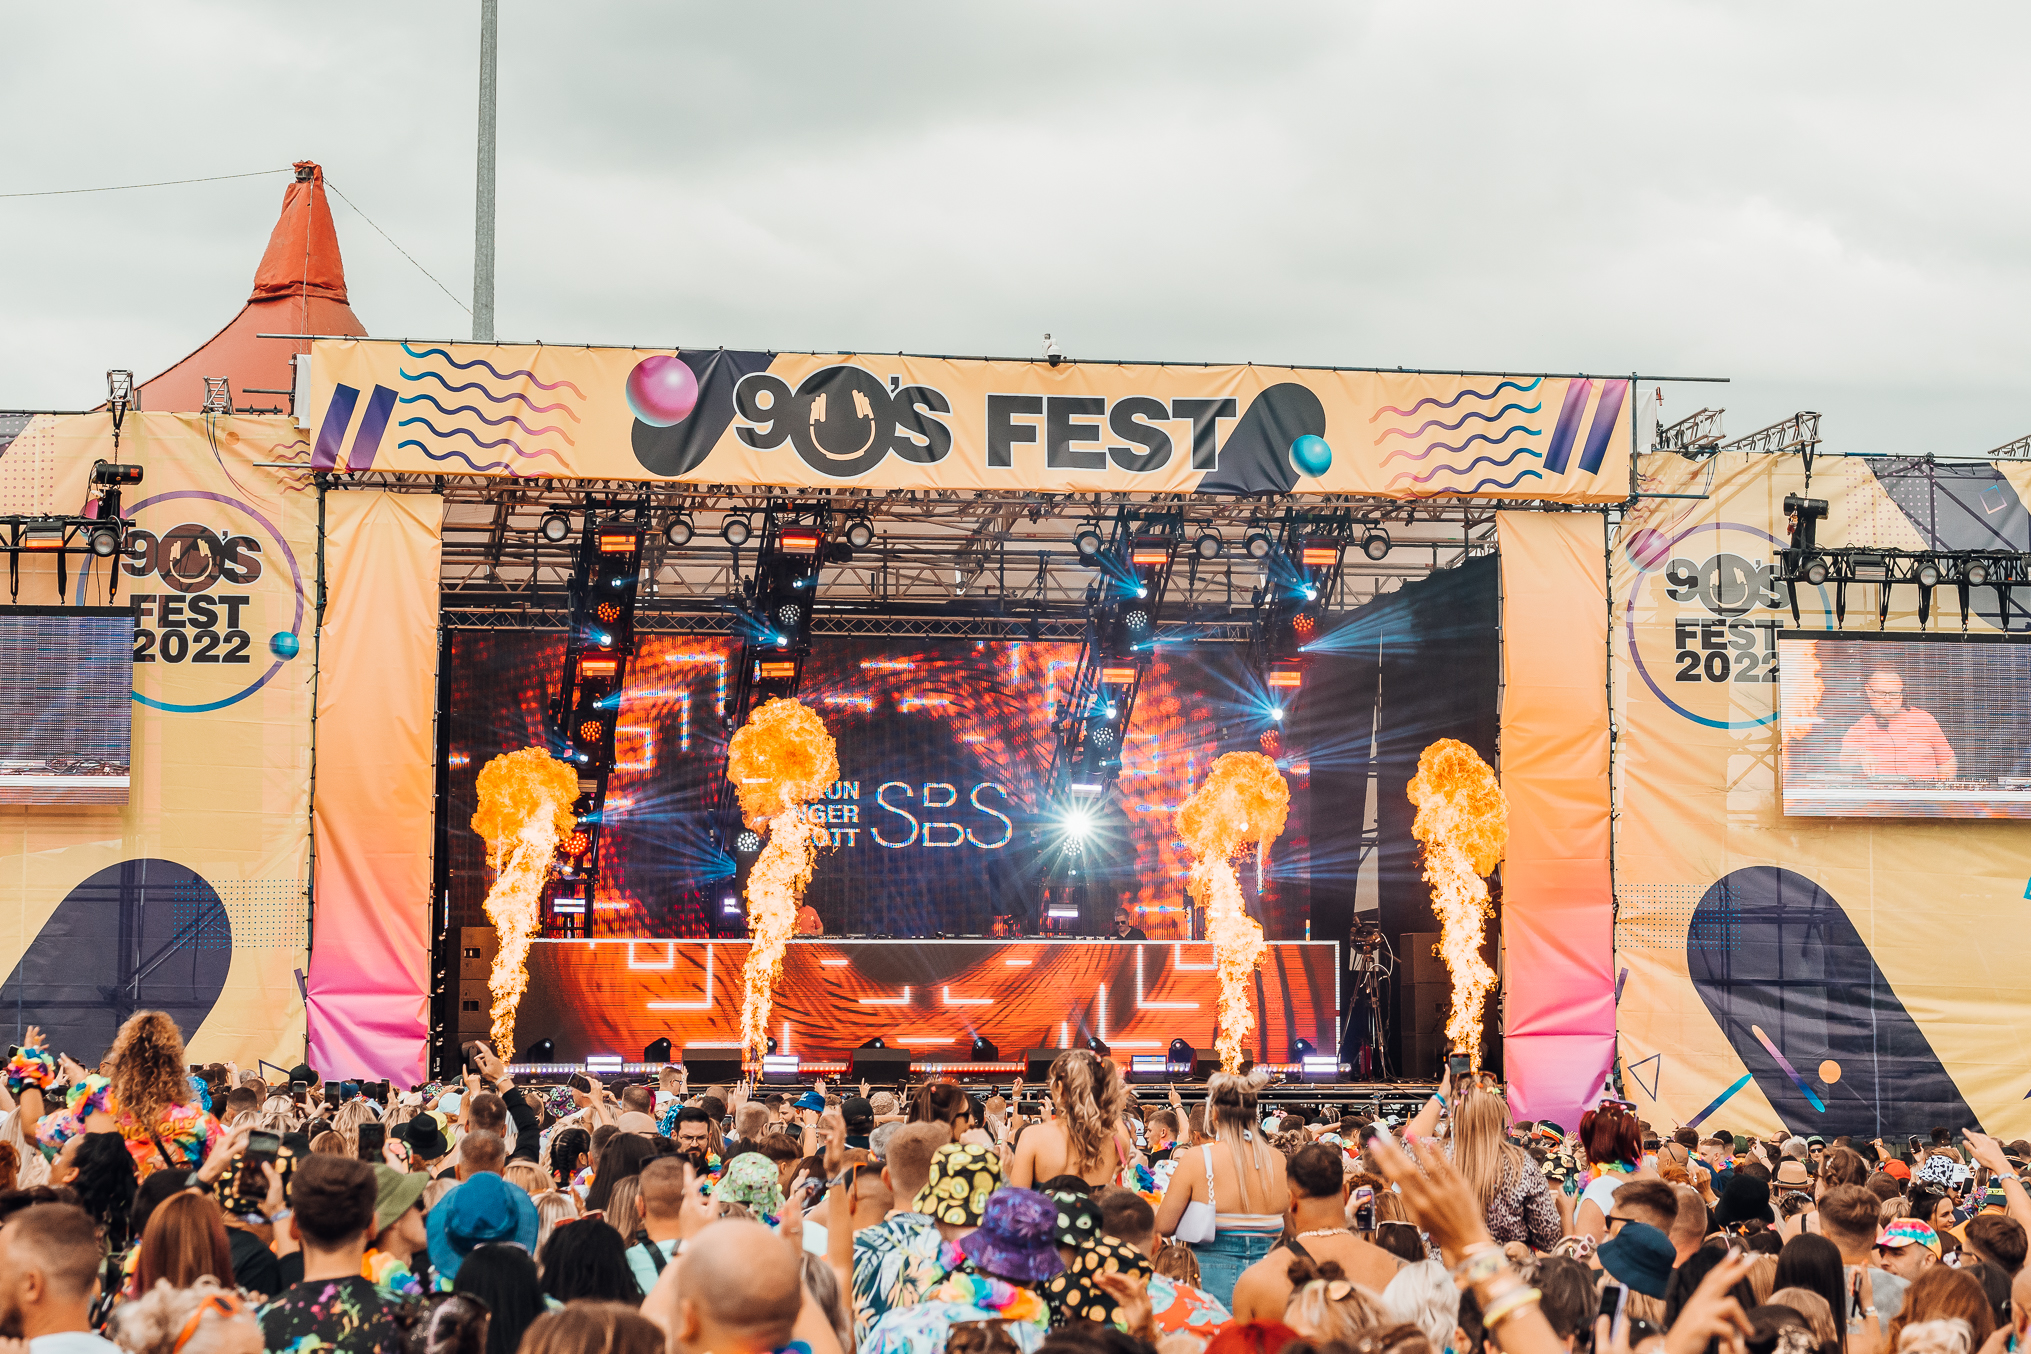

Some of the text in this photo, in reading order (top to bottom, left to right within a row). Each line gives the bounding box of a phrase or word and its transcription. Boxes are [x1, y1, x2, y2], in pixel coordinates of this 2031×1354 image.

[732, 364, 1238, 477] 90'S FEST
[130, 593, 250, 629] FEST
[133, 628, 251, 663] 2022
[1675, 617, 1784, 651] FEST
[1675, 650, 1780, 683] 2022
[870, 781, 1013, 849] SBS
